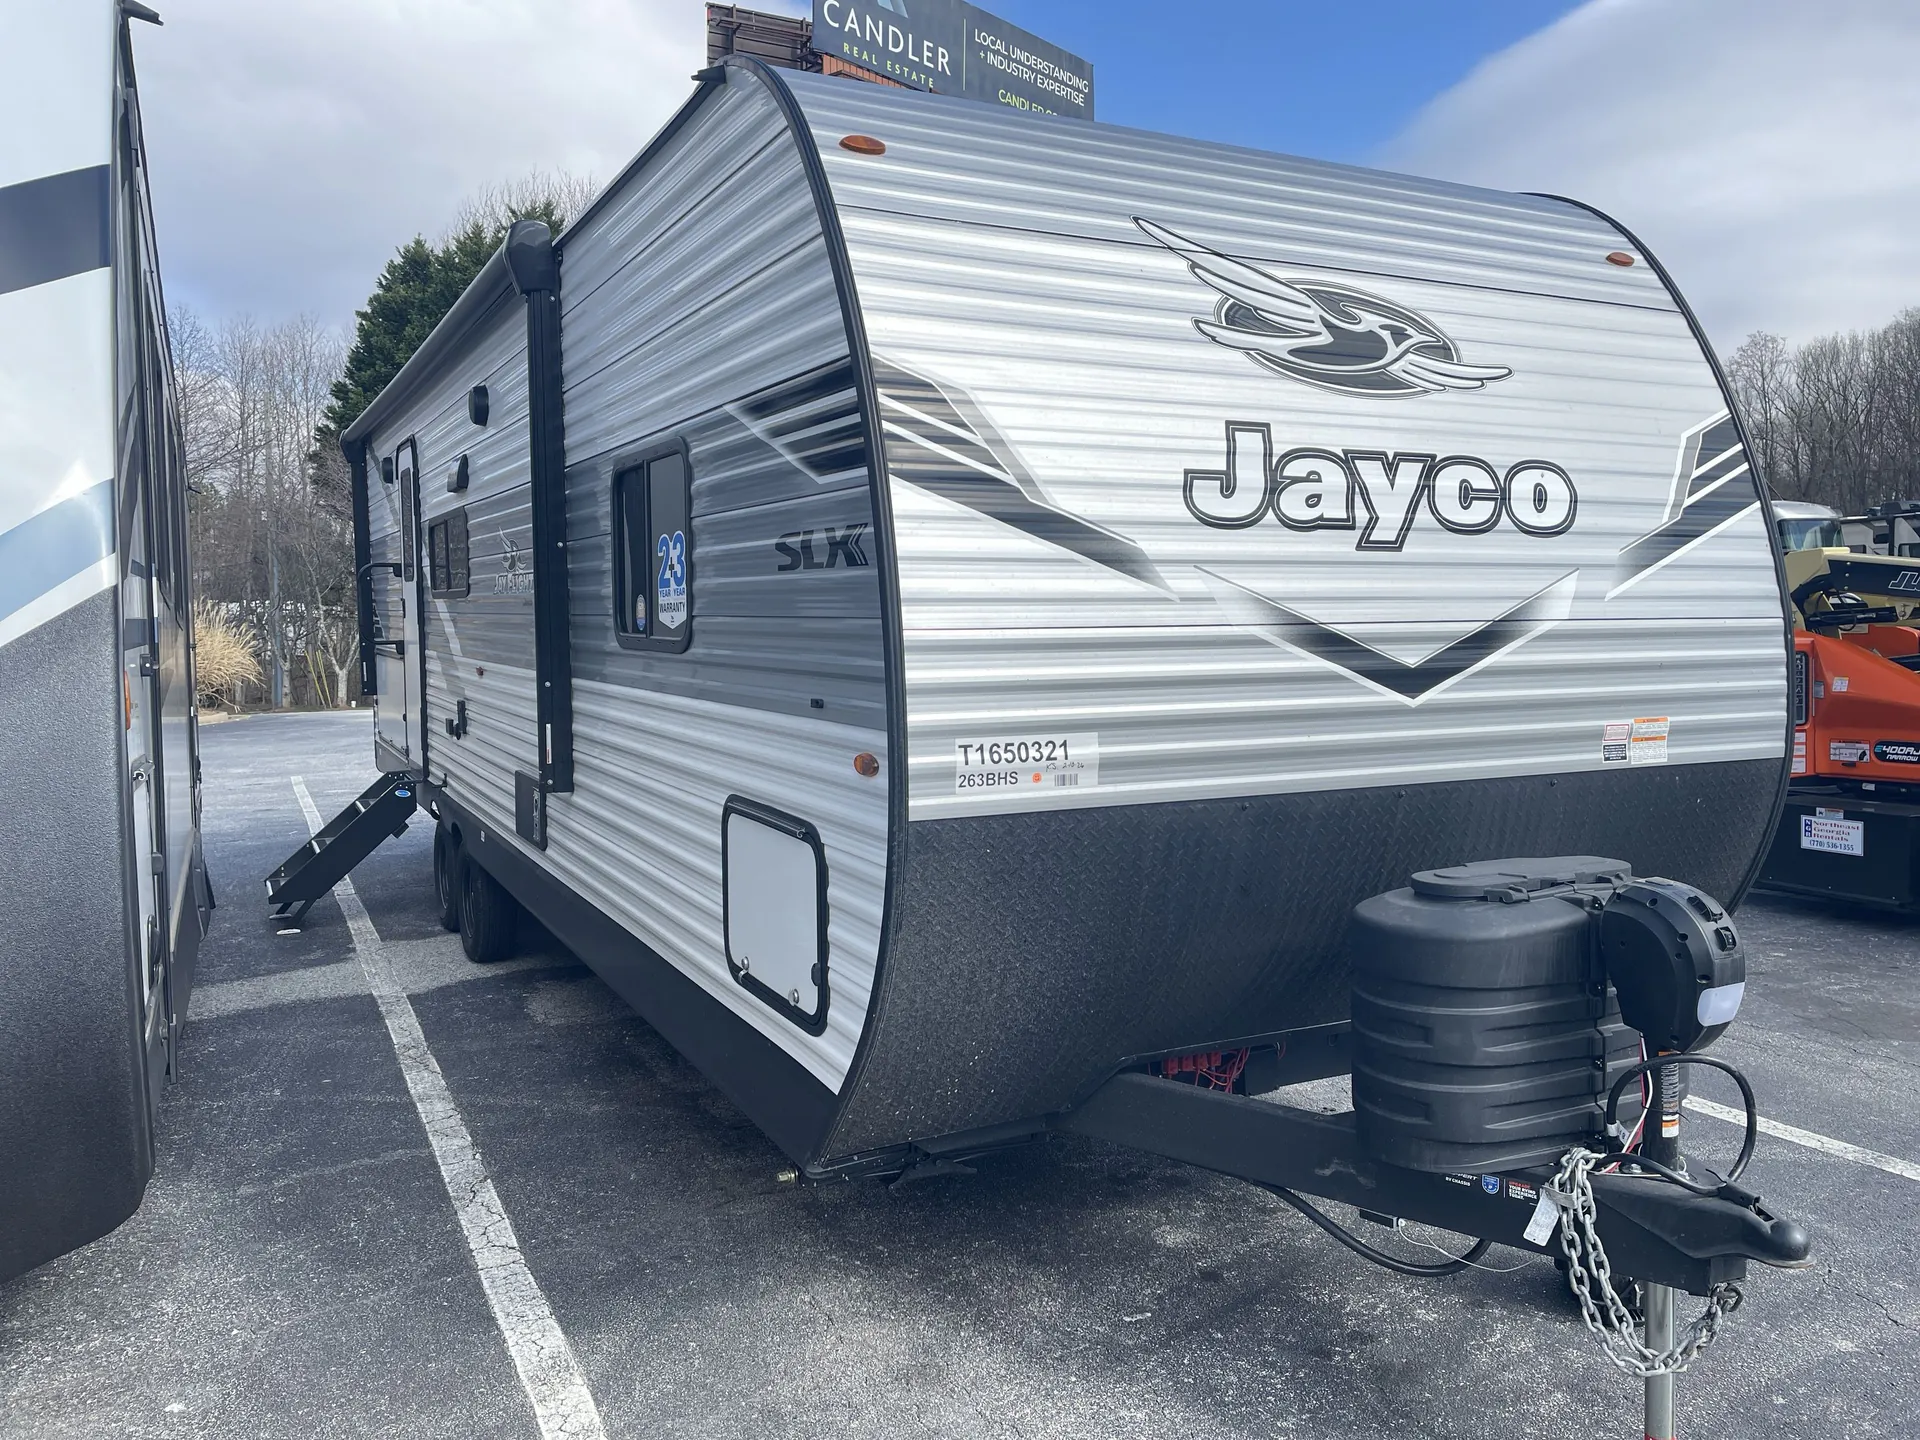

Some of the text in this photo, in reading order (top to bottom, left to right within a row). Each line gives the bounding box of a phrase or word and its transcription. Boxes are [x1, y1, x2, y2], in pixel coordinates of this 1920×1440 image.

[823, 0, 951, 76] CANDLER
[843, 42, 934, 88] REAL ESTATE
[975, 29, 1089, 93] LOCAL UNDERSTANDING
[980, 50, 1084, 106] + INDUSTRY EXPERTISE
[1183, 420, 1578, 552] Jayco
[775, 523, 869, 571] SLX
[1888, 571, 1920, 591] JL
[660, 587, 685, 598] YEAR YEAR
[660, 602, 685, 613] WARRANTY
[958, 740, 1069, 765] T1650321
[1886, 754, 1919, 762] NARROW
[958, 771, 1019, 788] 263BHS
[1813, 820, 1860, 831] Northeast
[1813, 826, 1850, 836] Georgia
[1809, 839, 1854, 851] (770) 536-1355
[1813, 832, 1849, 842] Rentals
[1452, 1177, 1471, 1187] CHASSIS
